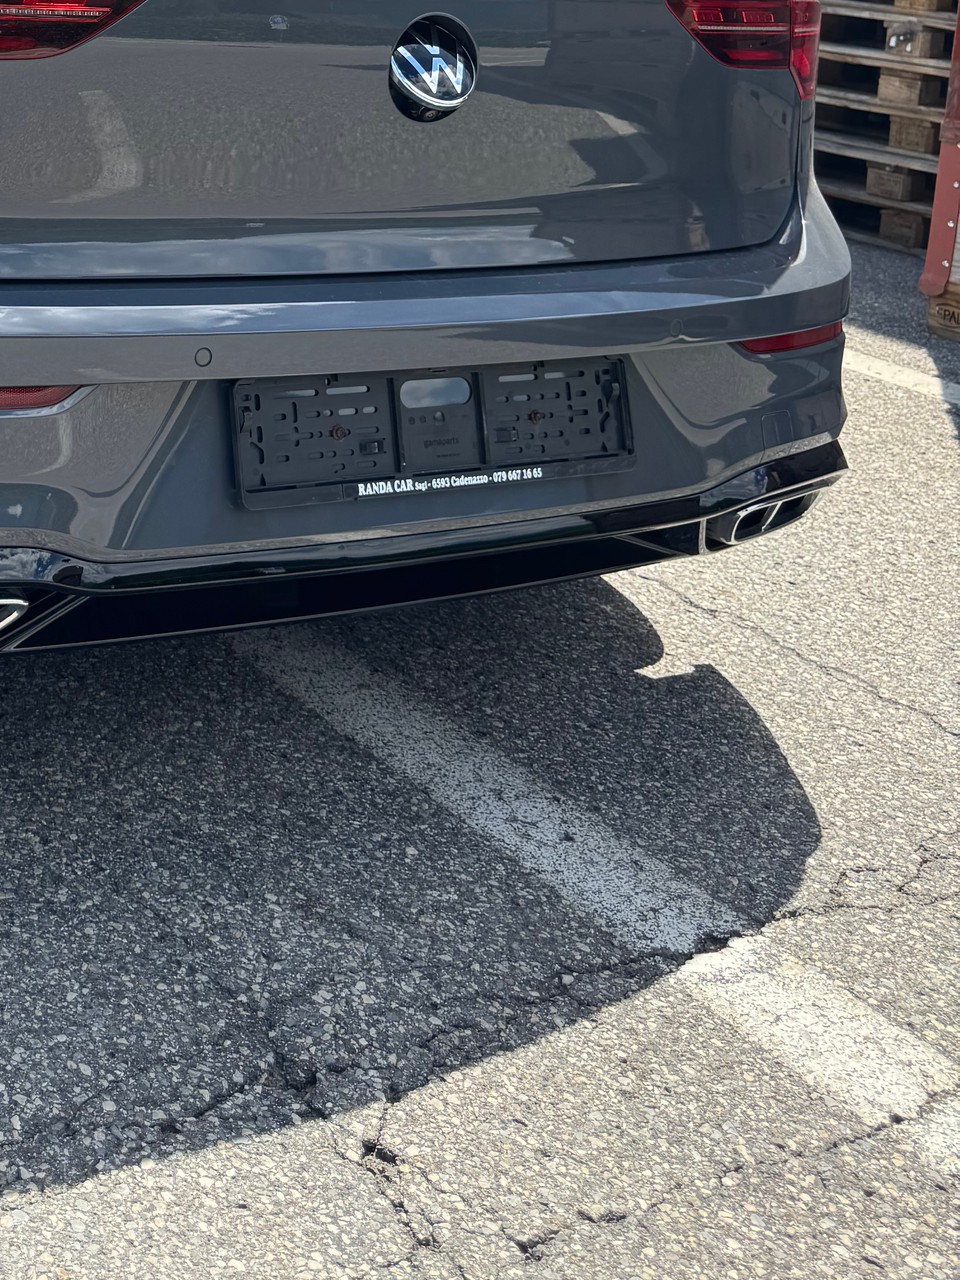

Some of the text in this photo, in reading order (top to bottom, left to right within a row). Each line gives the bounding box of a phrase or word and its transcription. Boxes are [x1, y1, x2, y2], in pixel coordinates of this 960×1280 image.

[358, 481, 393, 496] RANDA
[394, 479, 414, 493] CAR
[432, 477, 450, 489] 6593
[493, 471, 507, 483] 079
[508, 469, 522, 481] 667
[522, 468, 532, 479] 16
[533, 467, 542, 478] 65
